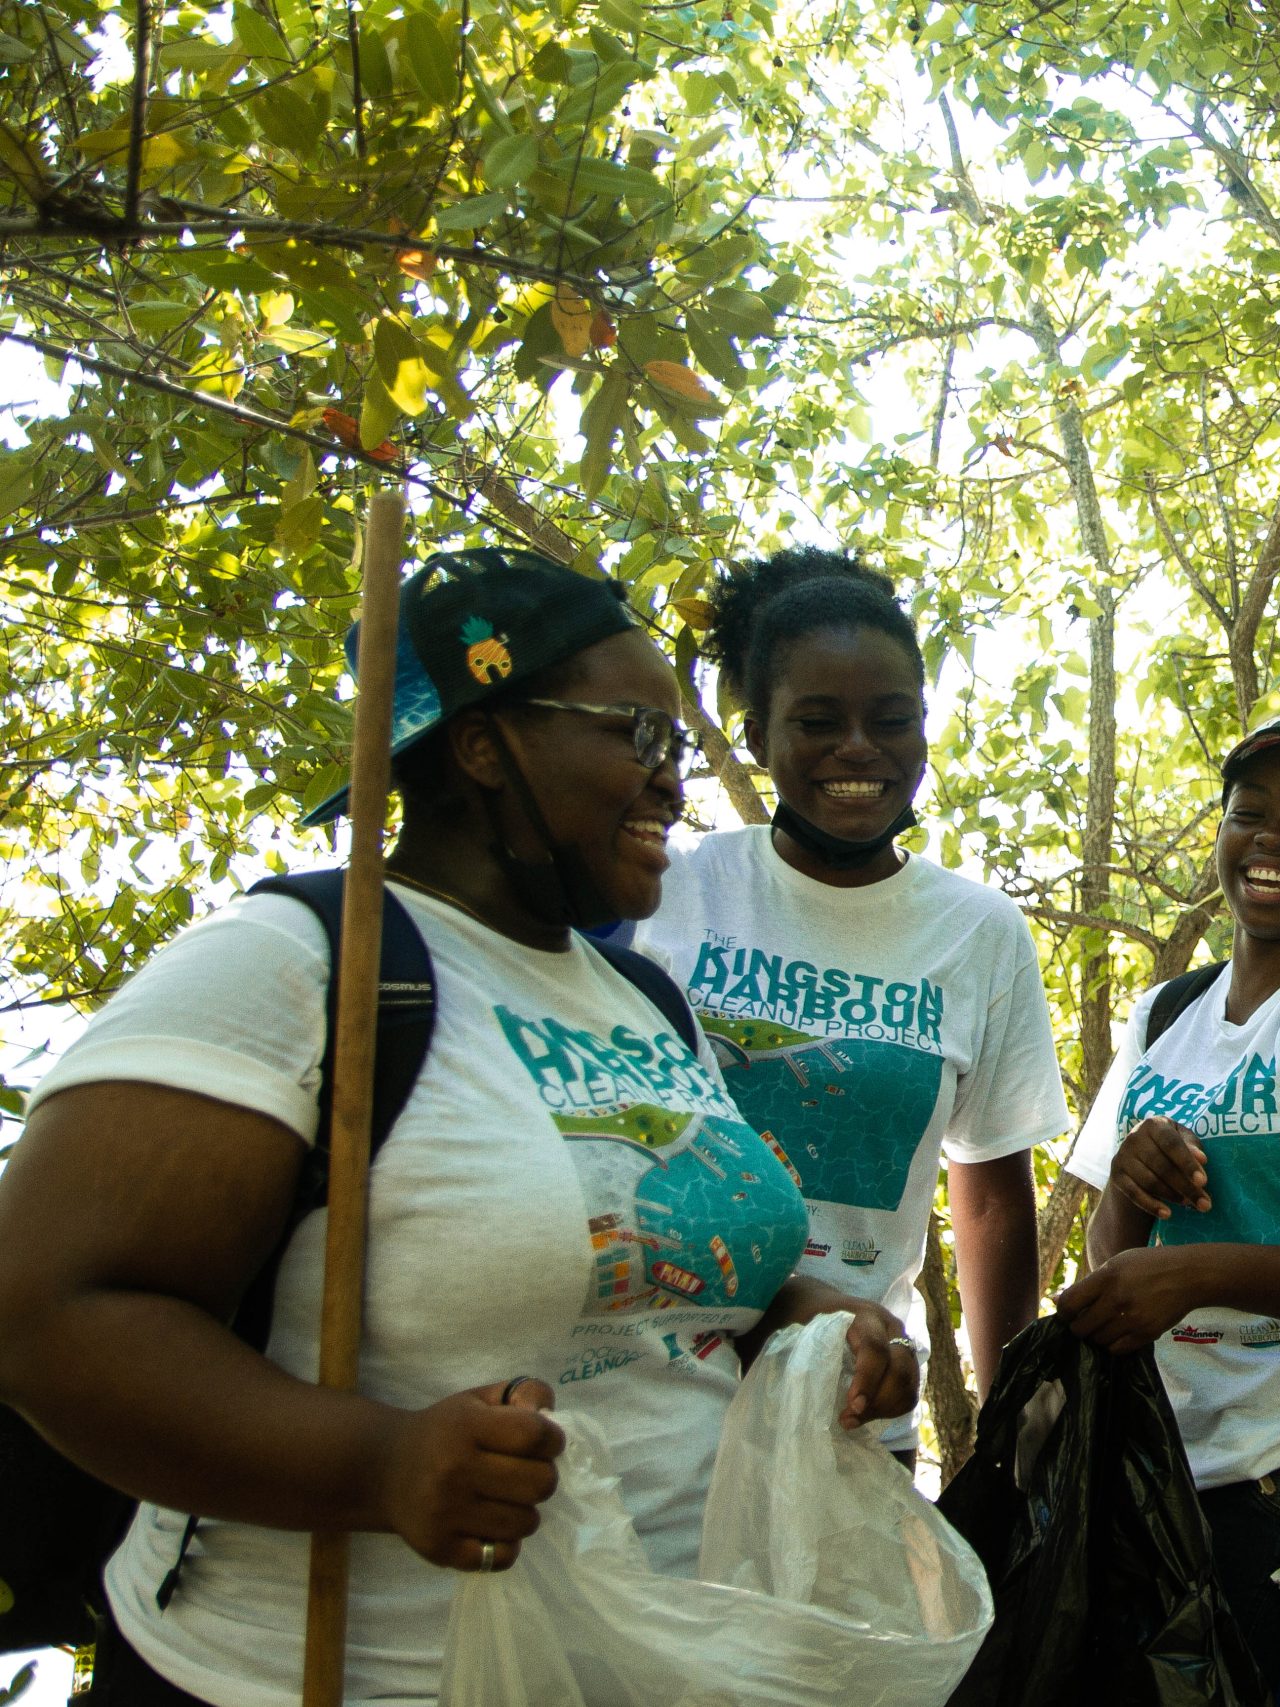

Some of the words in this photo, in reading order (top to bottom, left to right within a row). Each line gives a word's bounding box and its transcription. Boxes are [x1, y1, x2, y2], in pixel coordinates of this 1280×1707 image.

[703, 928, 737, 949] THE
[688, 964, 943, 1044] HARBOUR
[694, 941, 943, 1014] KINGSTON
[687, 987, 815, 1030] CLEANUP
[825, 1020, 943, 1054] PROJECT
[1192, 1109, 1277, 1138] OJECT
